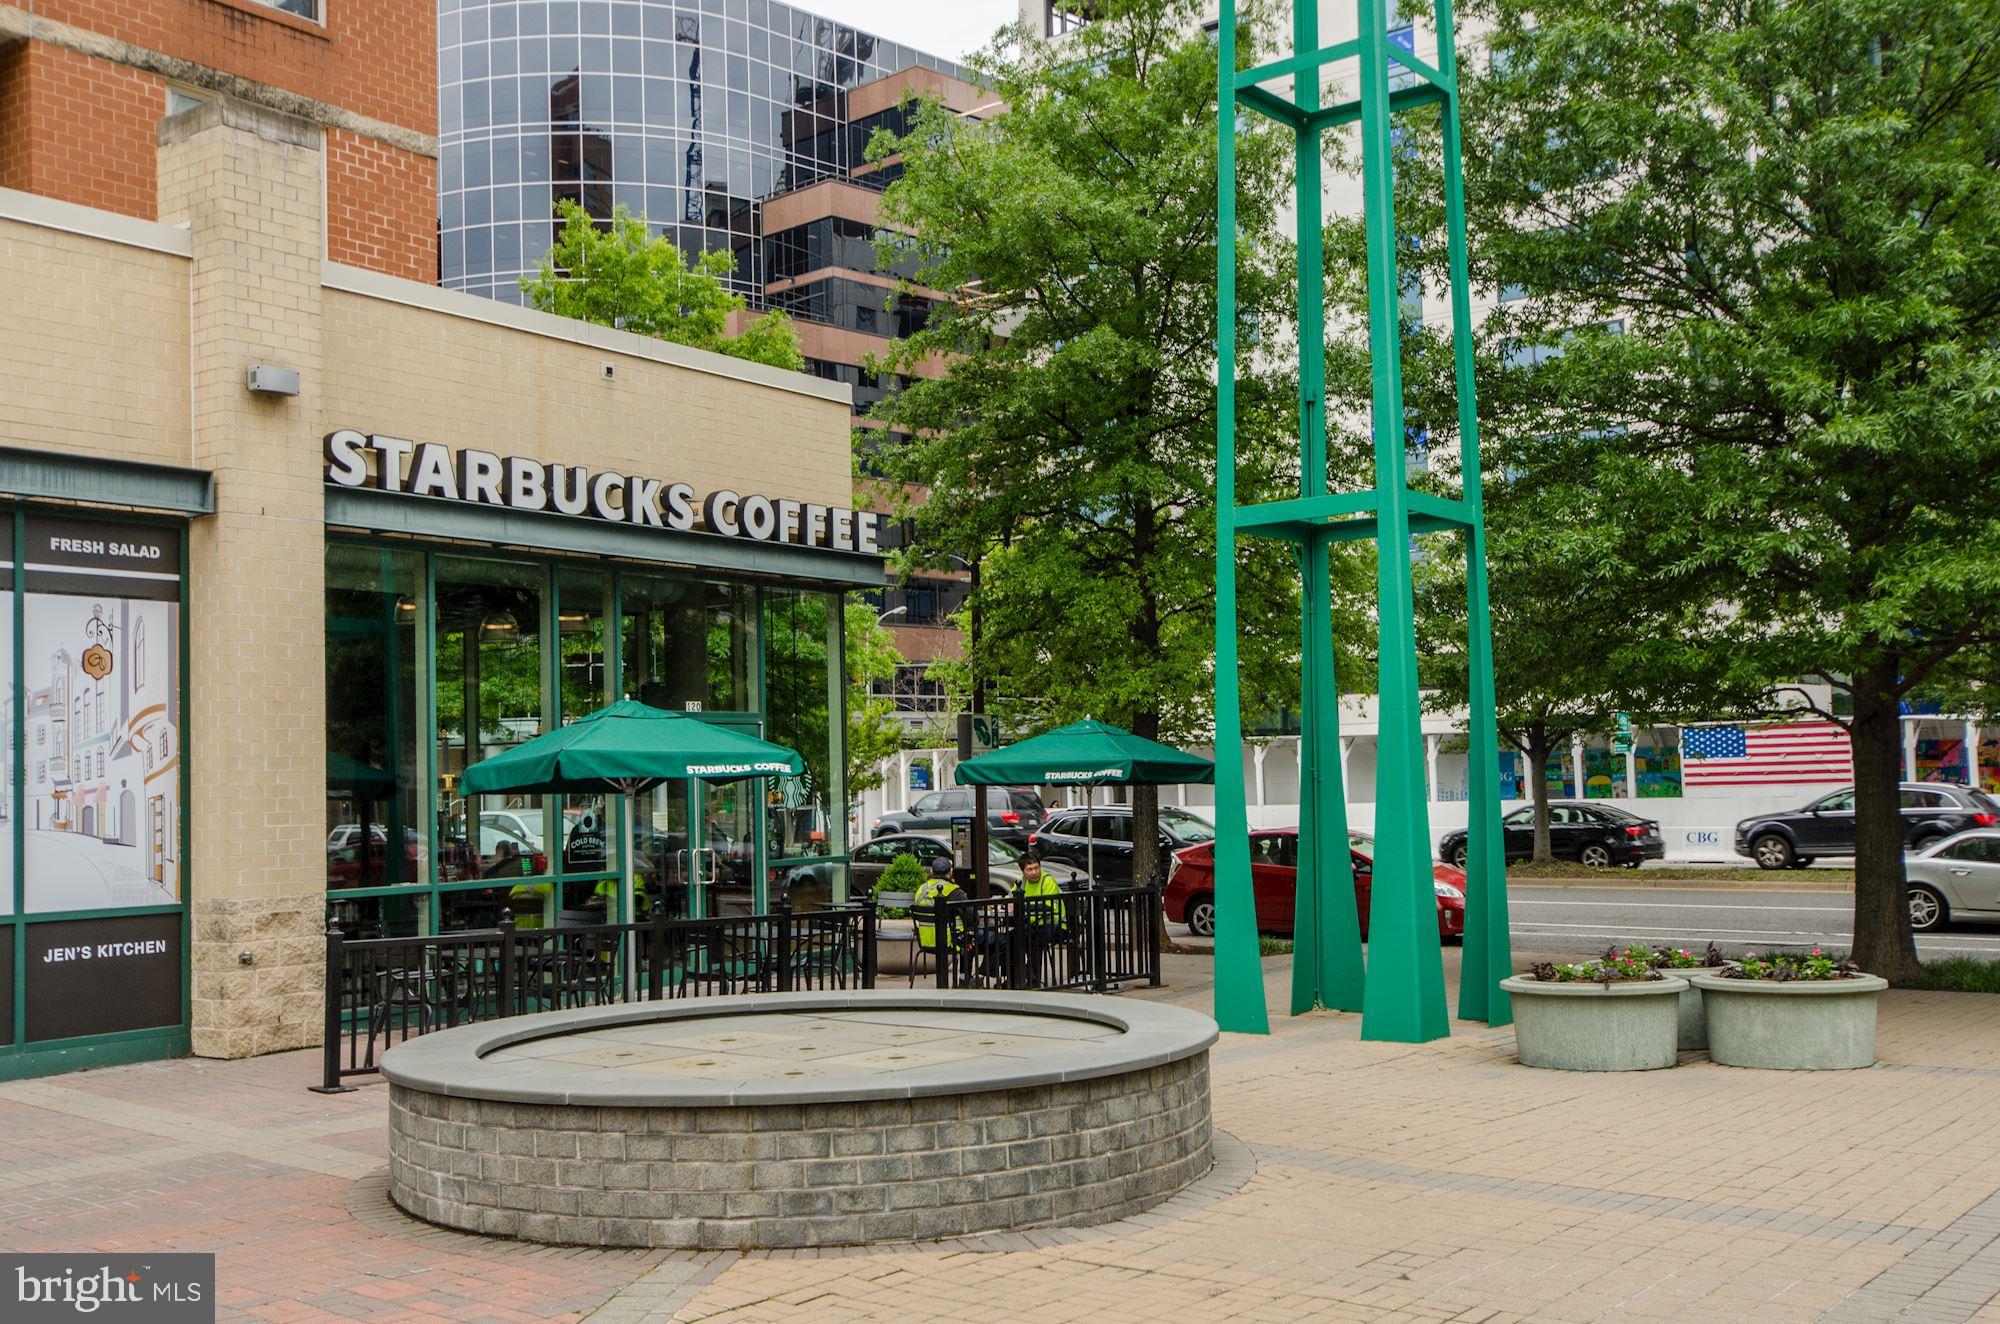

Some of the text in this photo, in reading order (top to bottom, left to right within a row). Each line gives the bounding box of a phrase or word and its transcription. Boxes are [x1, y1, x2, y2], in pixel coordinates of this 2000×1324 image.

[323, 429, 878, 554] STARBUCKS COFFEE
[50, 537, 161, 559] FRESH SALAD
[687, 702, 701, 712] 120
[686, 762, 792, 774] STARBUCKS COFFEE
[1045, 771, 1093, 780] STARBUCKS
[570, 837, 606, 849] COLD BREW
[1686, 831, 1718, 844] CBG
[43, 940, 166, 963] JEN'S KITCHEN
